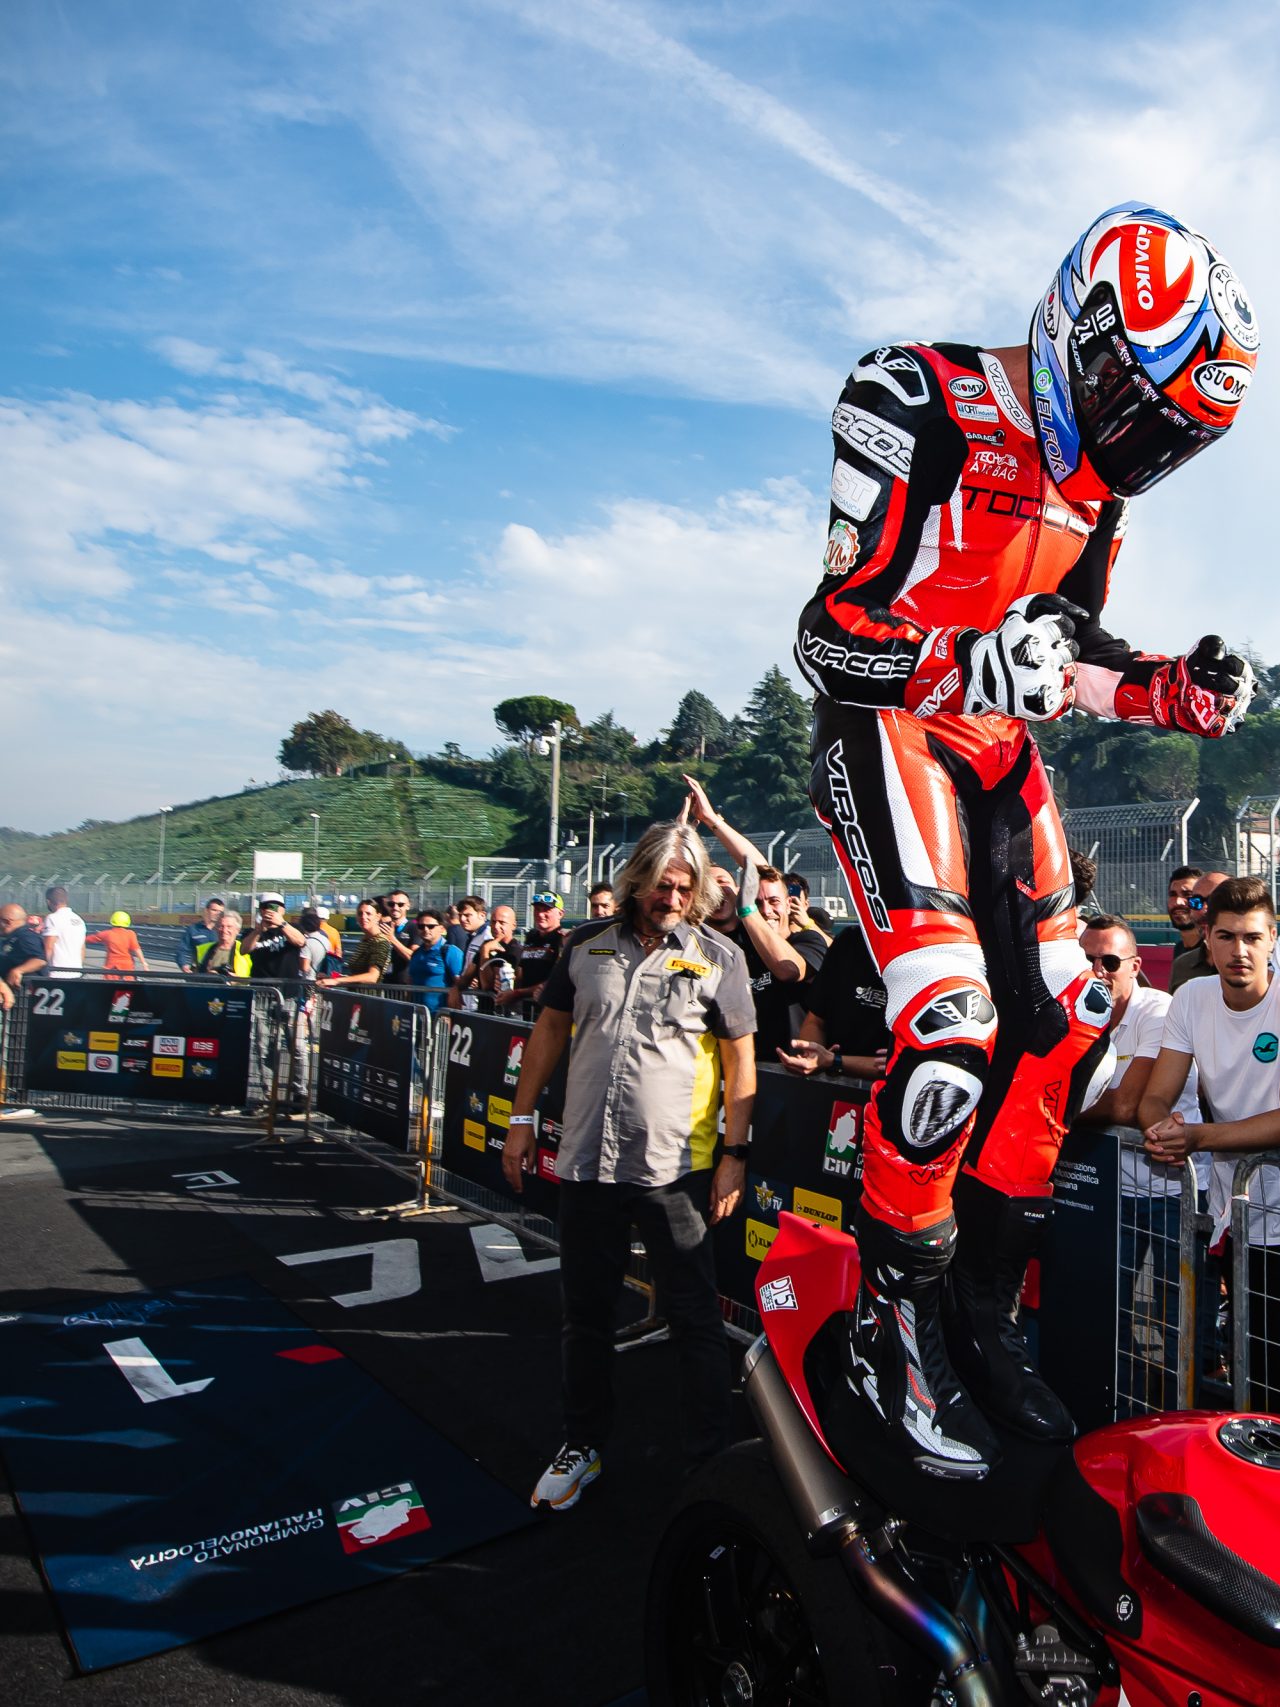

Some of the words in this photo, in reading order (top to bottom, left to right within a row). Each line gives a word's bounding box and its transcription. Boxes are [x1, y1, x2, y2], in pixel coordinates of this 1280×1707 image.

[1074, 318, 1094, 345] 24
[950, 381, 983, 393] SUOMY
[988, 362, 1033, 430] VIRCOS
[1203, 365, 1247, 398] SUOM
[1036, 396, 1067, 477] ELFOR
[801, 629, 914, 679] VIRCOS
[826, 738, 894, 933] VIRCOS
[32, 987, 66, 1016] 22
[449, 1024, 474, 1067] 22
[803, 1205, 839, 1223] DUNLOP
[194, 1517, 325, 1564] CAMPIONATO
